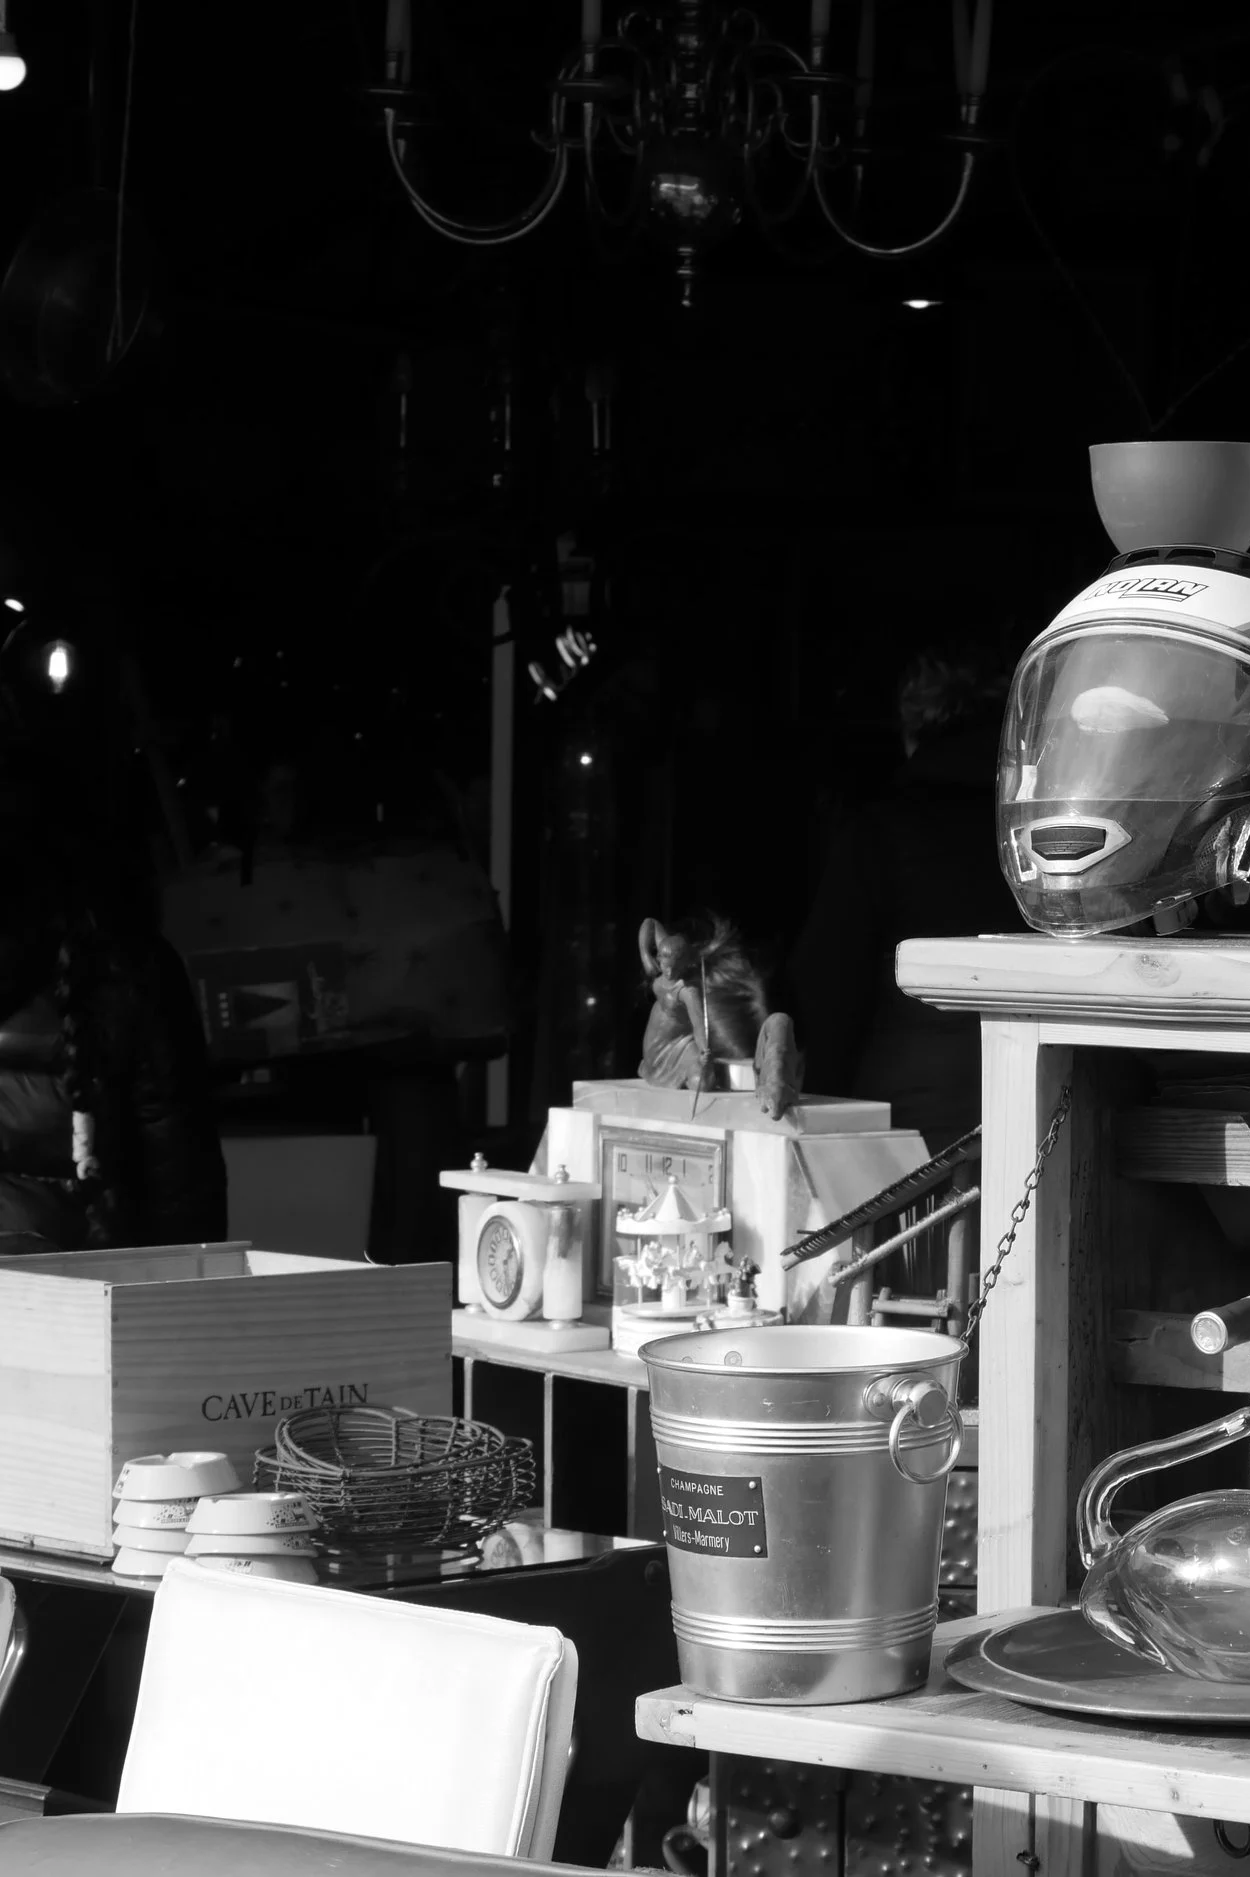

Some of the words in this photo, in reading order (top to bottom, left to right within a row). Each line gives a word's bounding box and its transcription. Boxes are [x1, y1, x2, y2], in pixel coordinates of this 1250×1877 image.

[1083, 577, 1210, 602] NOLAN
[618, 1153, 628, 1173] 10
[662, 1156, 673, 1176] 12
[201, 1391, 277, 1422] CAVE
[280, 1396, 303, 1411] DE
[303, 1383, 369, 1408] TAIN
[670, 1478, 724, 1496] CHAMPAGNE
[673, 1524, 730, 1553] Villers-Marmery
